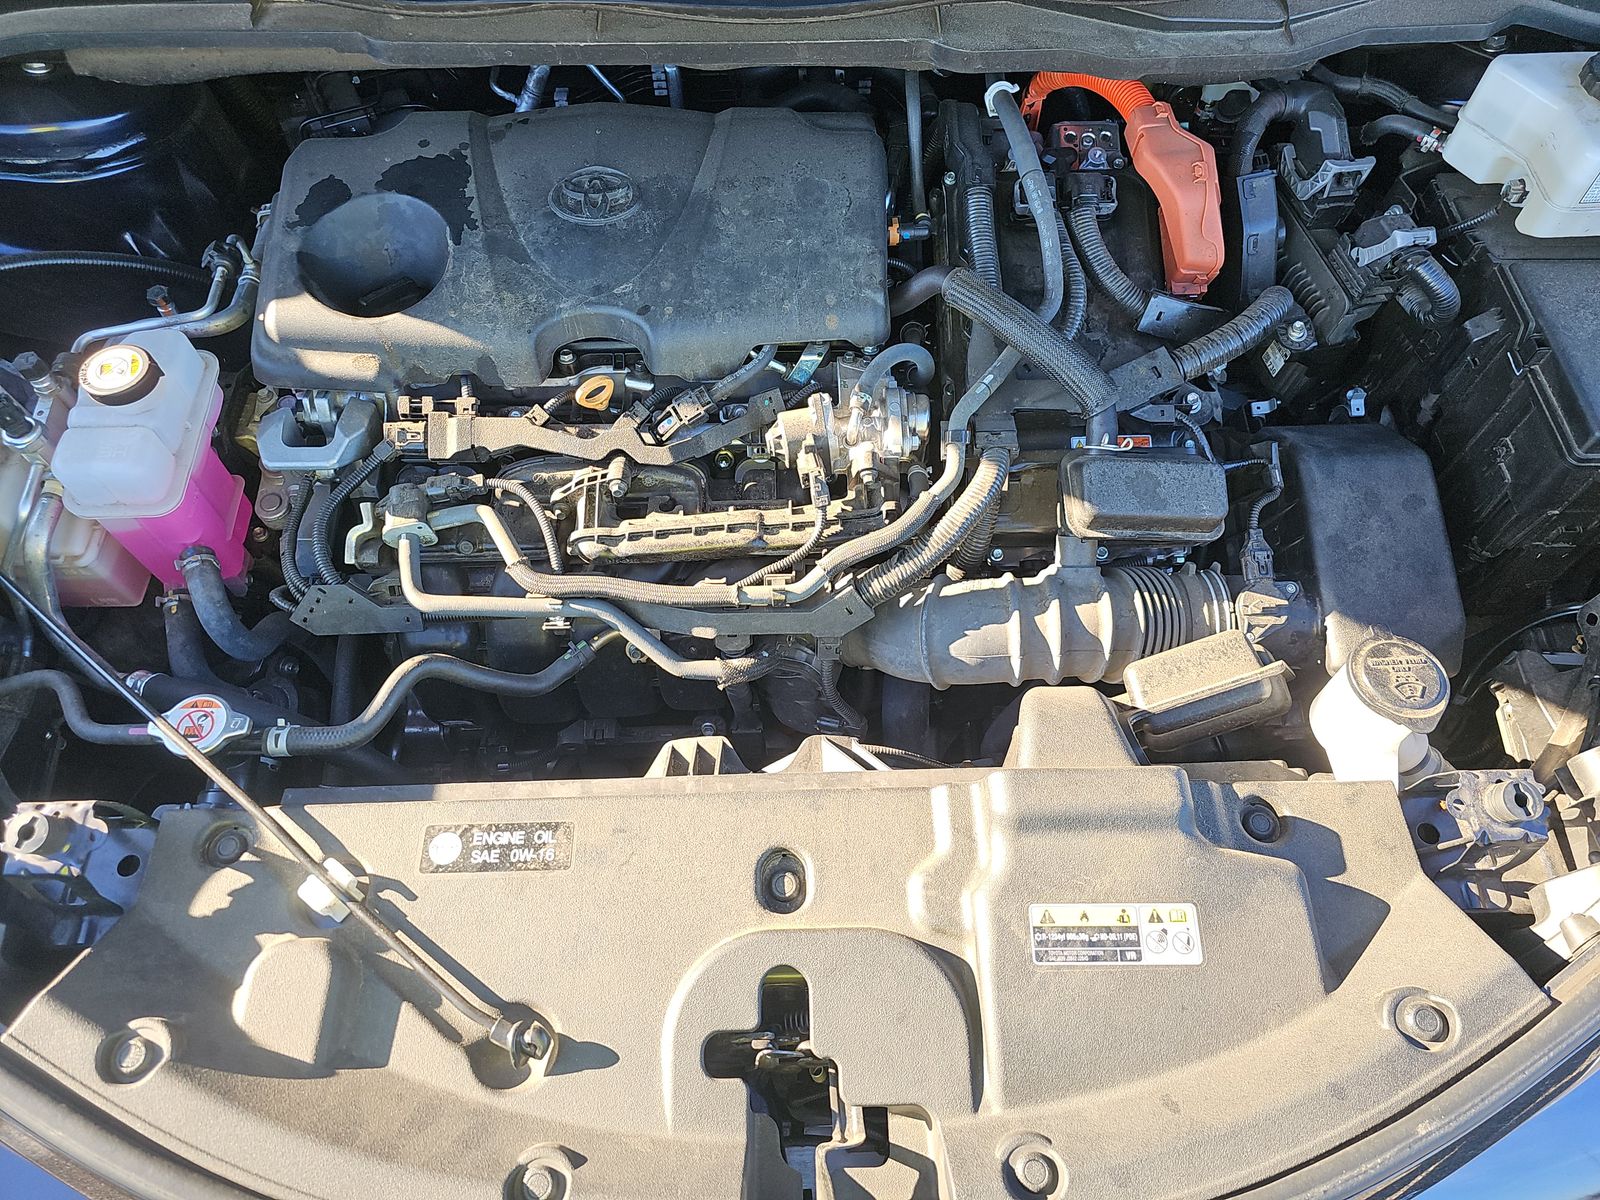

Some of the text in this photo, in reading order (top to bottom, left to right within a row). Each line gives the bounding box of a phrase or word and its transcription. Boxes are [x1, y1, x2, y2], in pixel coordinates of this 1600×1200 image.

[473, 830, 556, 845] ENGINE OIL
[471, 848, 555, 864] SAE 0W-16
